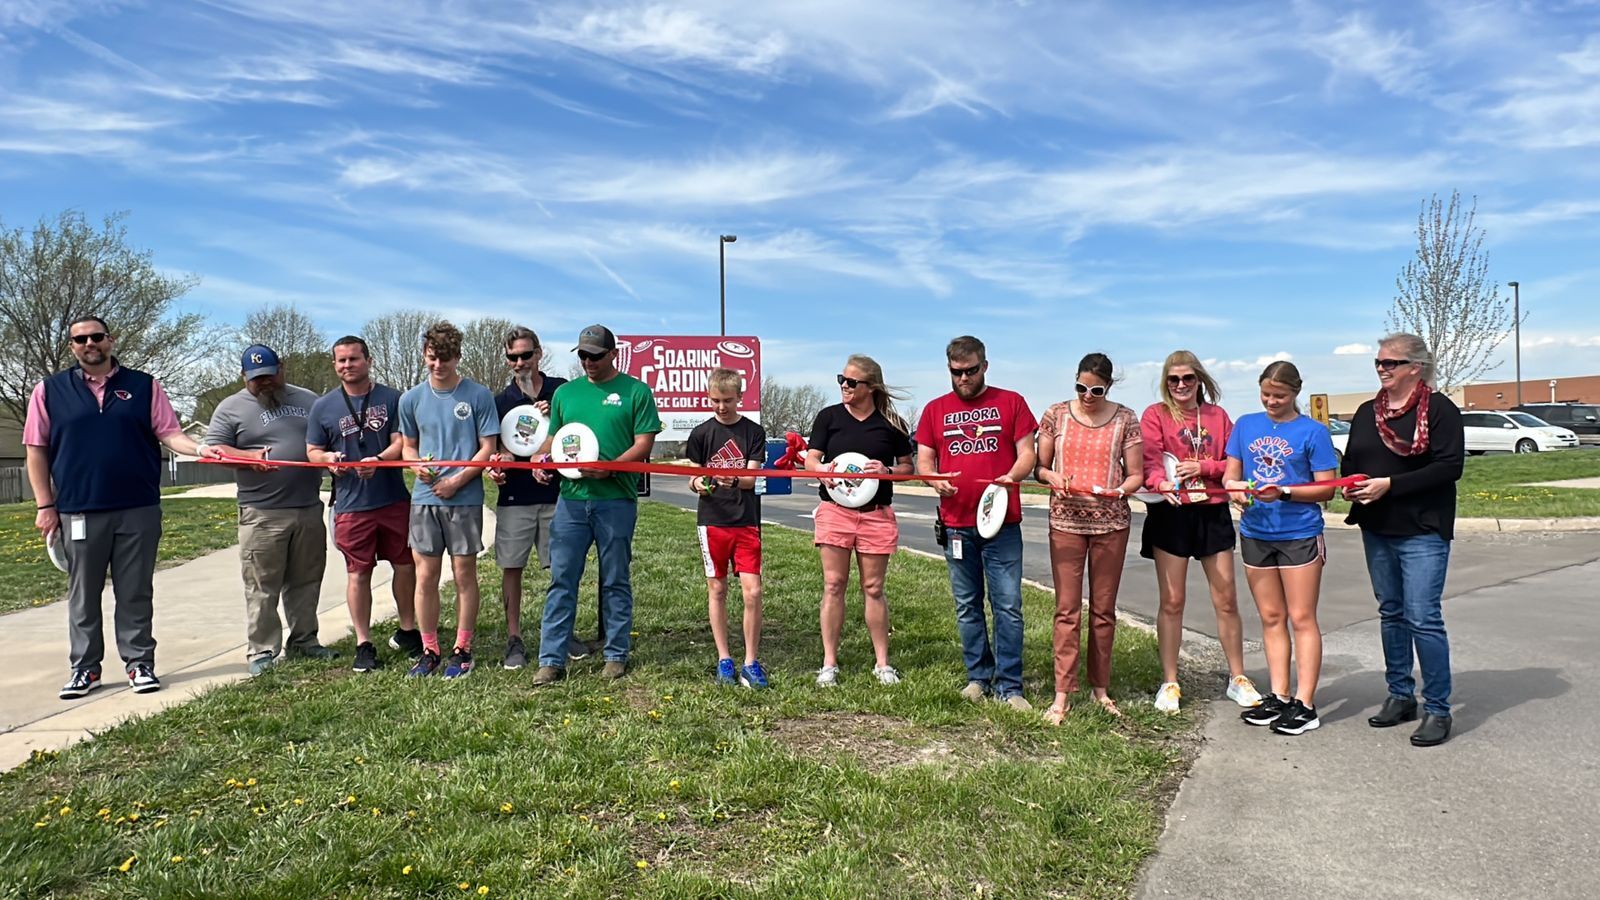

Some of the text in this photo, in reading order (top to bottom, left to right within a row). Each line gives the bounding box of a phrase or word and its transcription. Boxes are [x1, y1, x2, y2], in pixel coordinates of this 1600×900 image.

[251, 353, 263, 364] KC
[672, 397, 700, 408] GOLF
[943, 407, 1001, 425] EUDORA
[949, 437, 998, 456] SOAR
[1248, 436, 1293, 457] EUDORA
